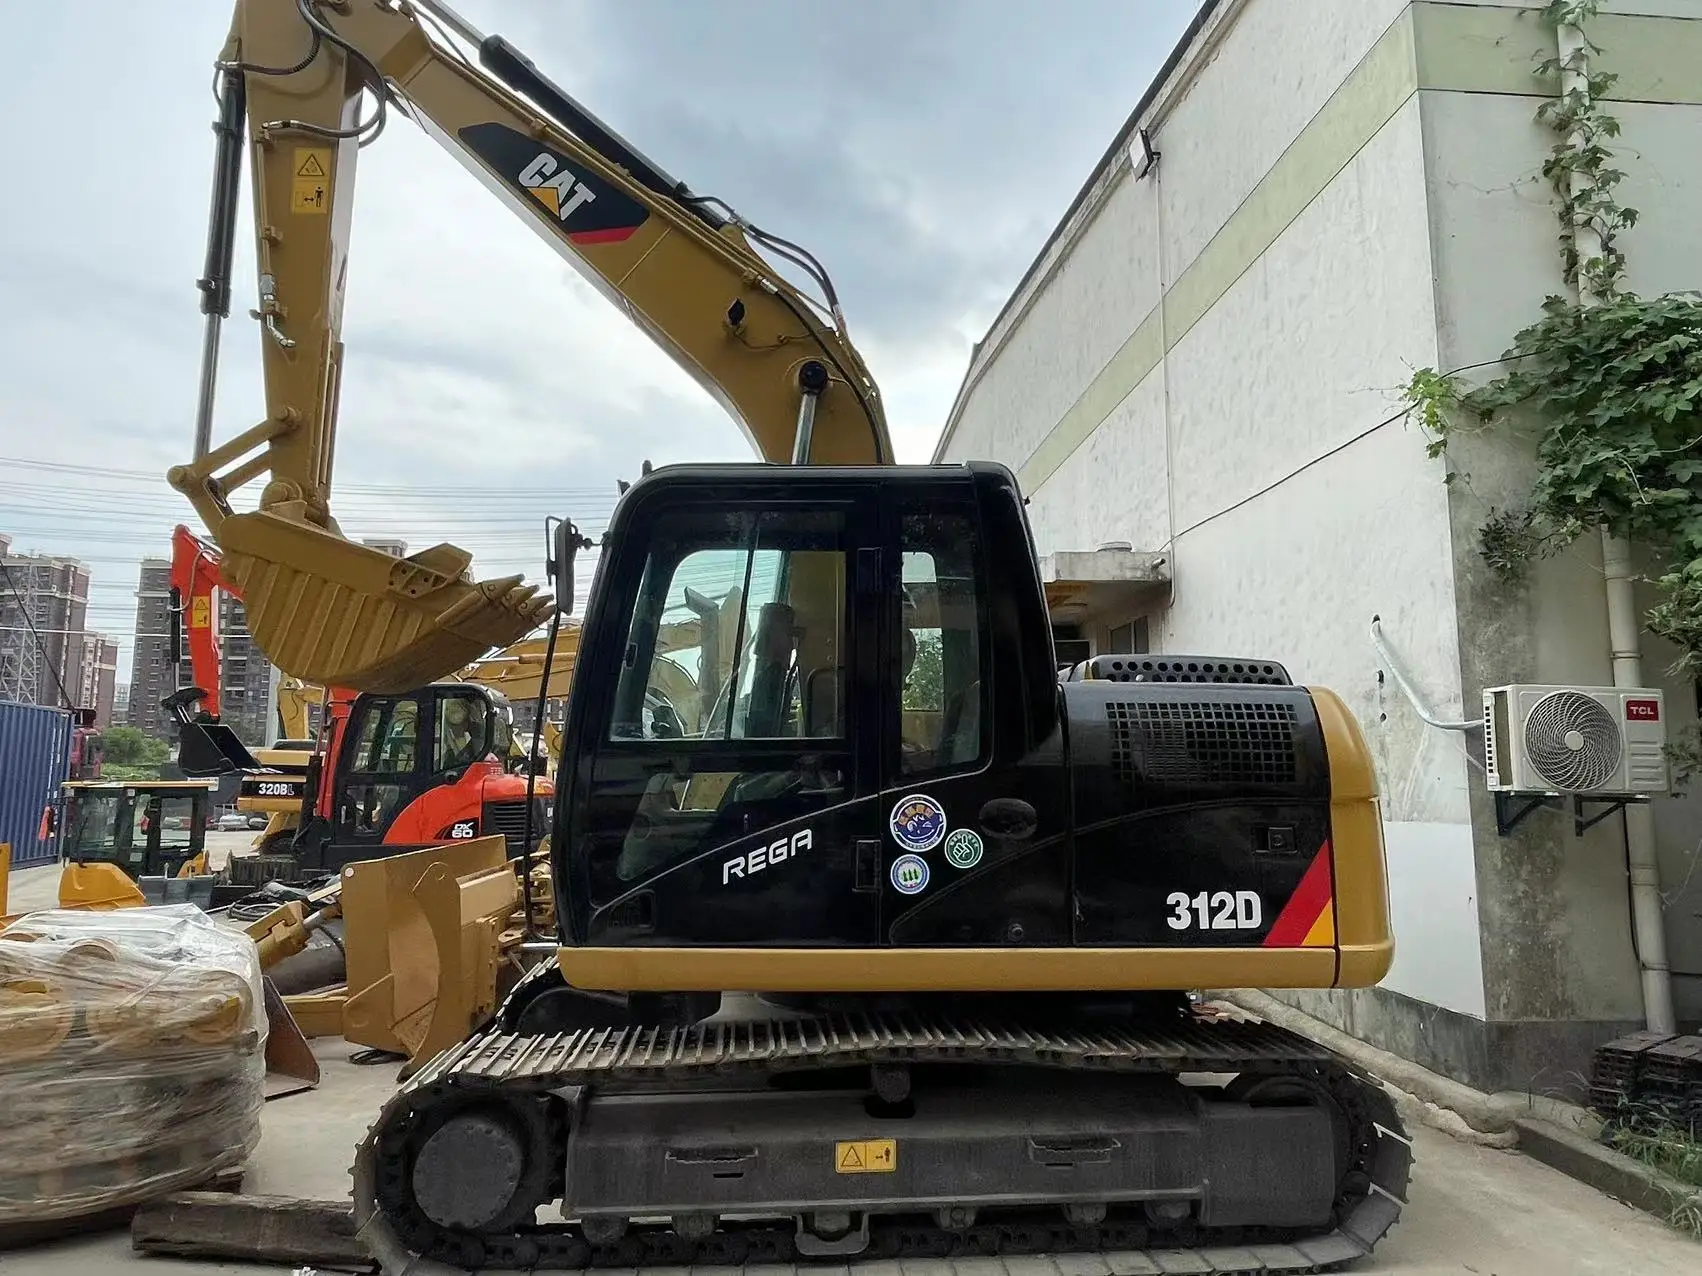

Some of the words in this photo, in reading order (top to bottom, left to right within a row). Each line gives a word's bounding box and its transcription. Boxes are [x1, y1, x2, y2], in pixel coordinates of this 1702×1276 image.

[518, 152, 597, 221] CAT
[1629, 706, 1655, 715] TCL
[451, 829, 474, 839] 60
[723, 828, 813, 885] REGA
[1166, 891, 1262, 930] 312D
